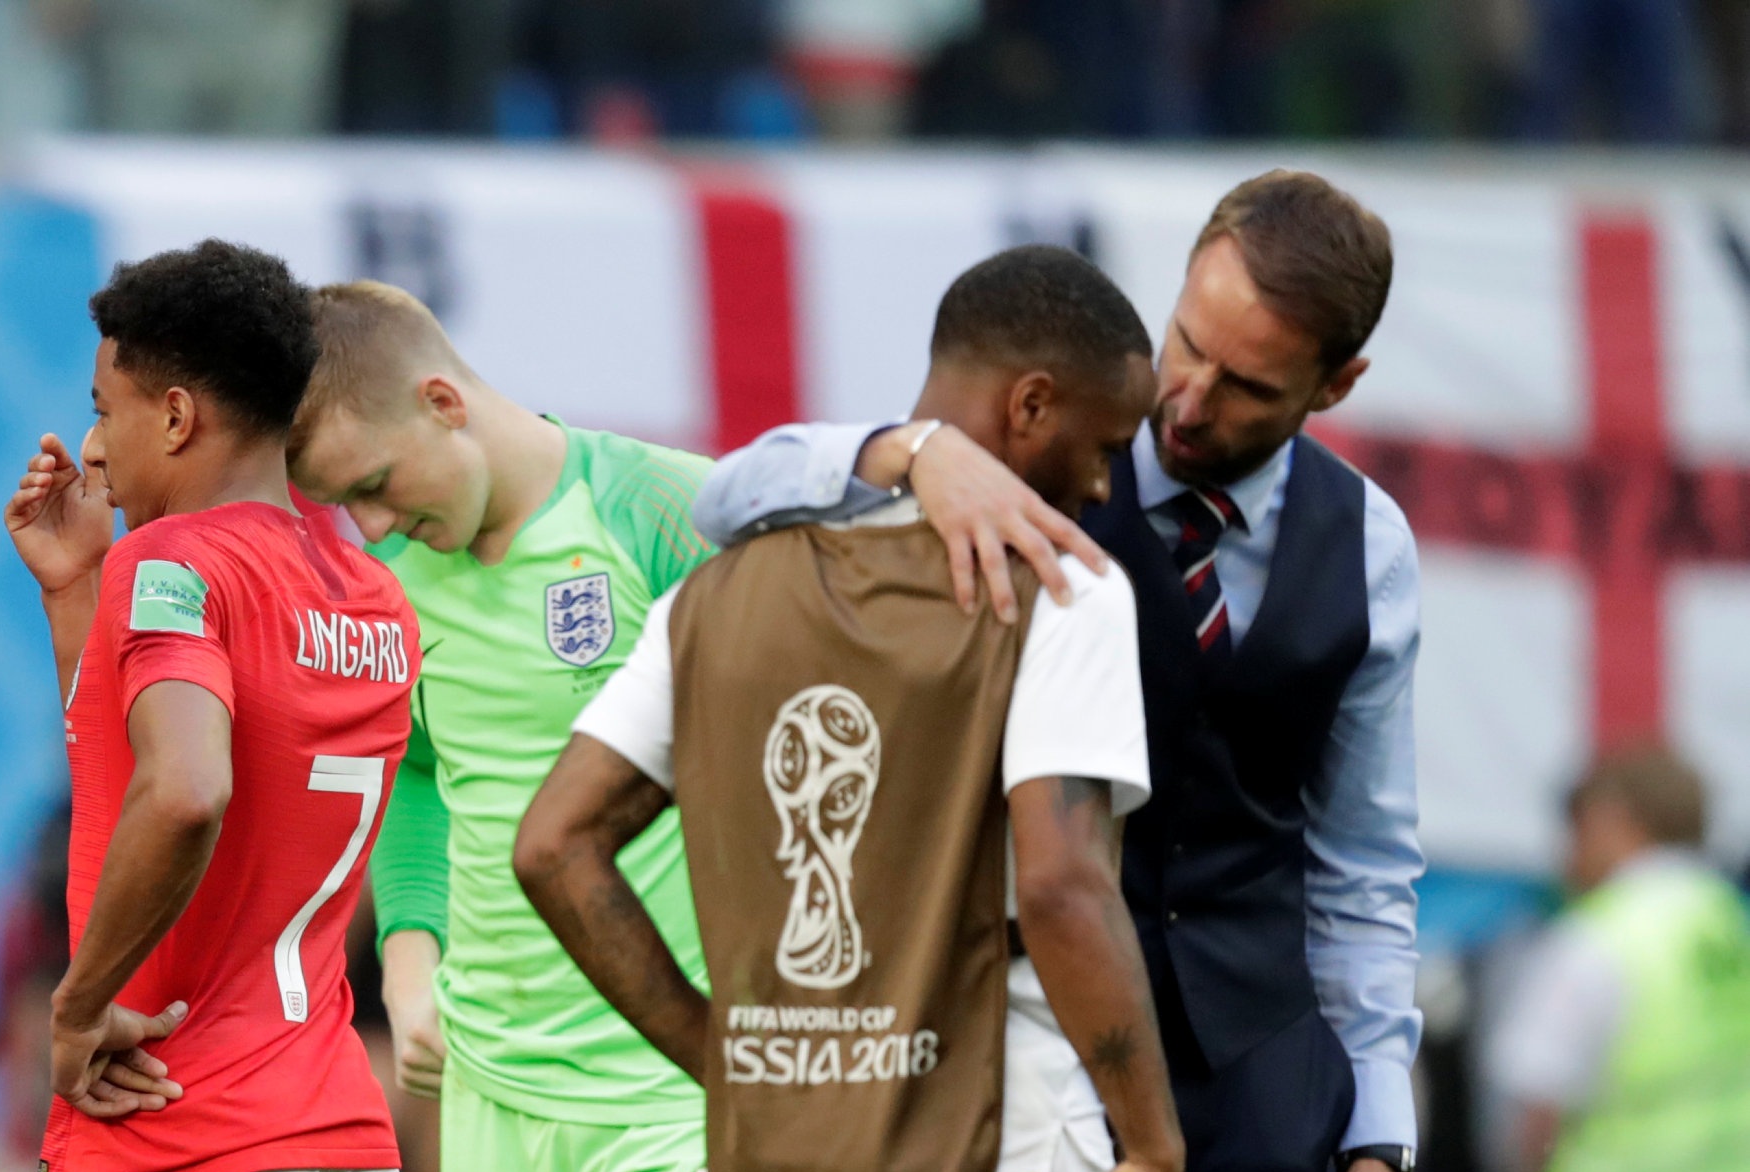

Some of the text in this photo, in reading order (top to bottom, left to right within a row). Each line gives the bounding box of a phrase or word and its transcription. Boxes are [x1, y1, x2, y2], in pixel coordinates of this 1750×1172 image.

[294, 607, 410, 684] LINGARD
[273, 754, 386, 1024] 7
[727, 1005, 780, 1031] FIFA
[780, 1006, 859, 1032] WORLD
[723, 1029, 939, 1086] SSIA 2018
